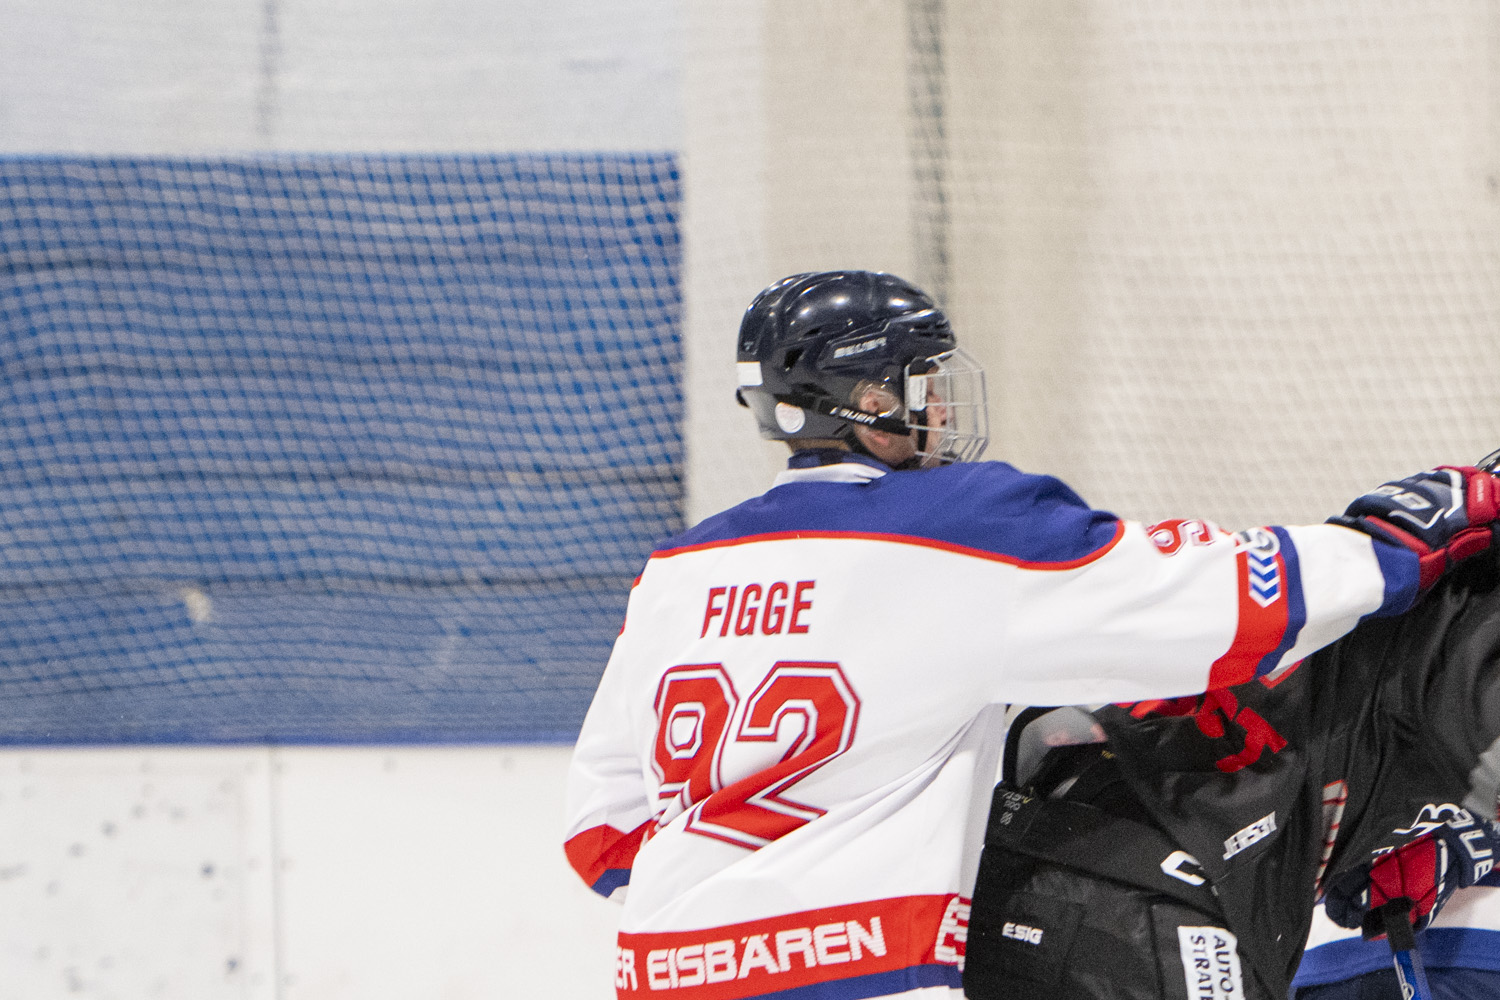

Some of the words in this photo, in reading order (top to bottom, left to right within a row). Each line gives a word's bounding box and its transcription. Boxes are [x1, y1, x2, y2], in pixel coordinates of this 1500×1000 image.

[700, 579, 816, 639] FIGGE
[648, 661, 861, 852] 92
[647, 916, 887, 991] EISBÄREN
